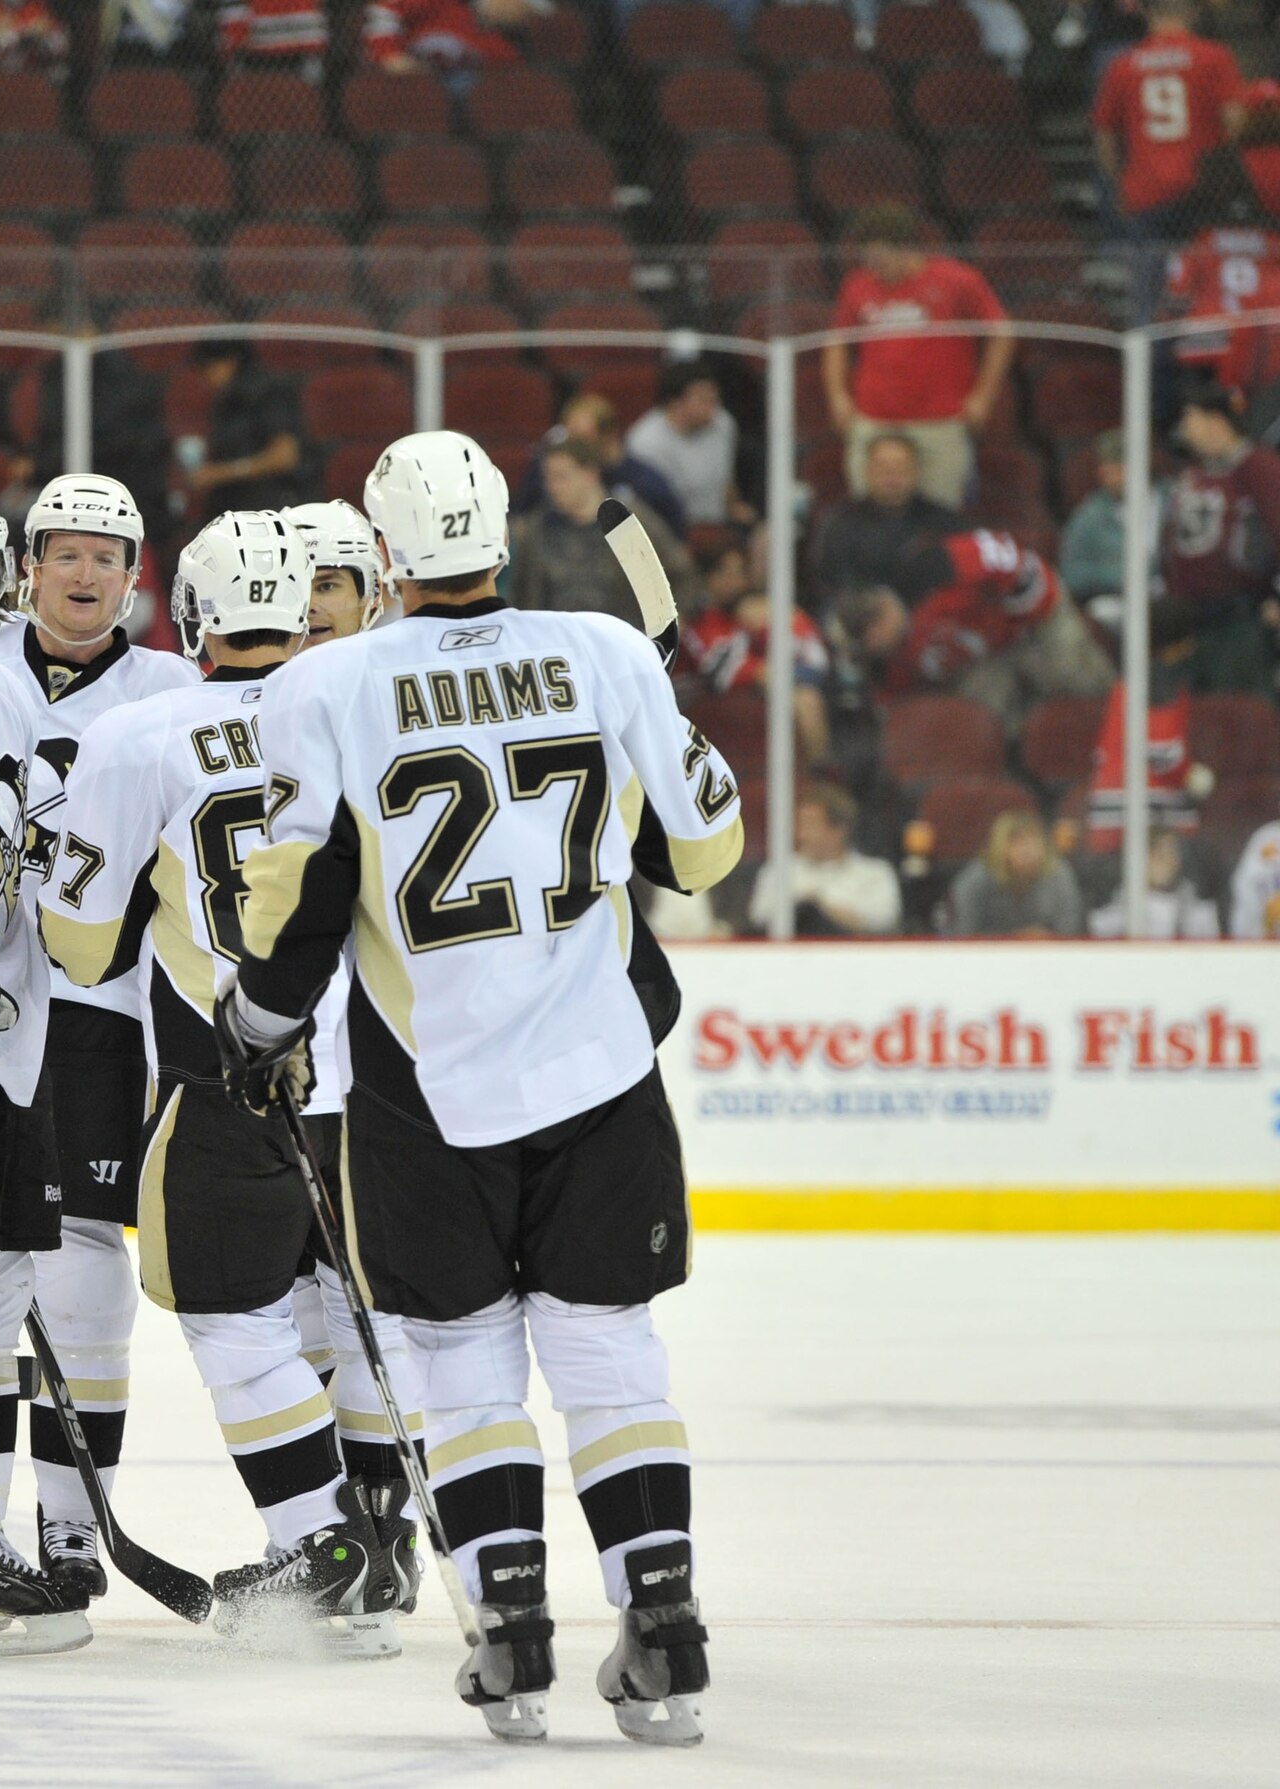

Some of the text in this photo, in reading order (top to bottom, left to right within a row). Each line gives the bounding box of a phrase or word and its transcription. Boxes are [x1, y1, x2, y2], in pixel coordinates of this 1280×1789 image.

[1142, 73, 1190, 141] 9
[72, 503, 111, 512] CCM
[441, 509, 471, 539] 27
[249, 580, 277, 603] 87
[393, 656, 577, 733] ADAMS
[191, 715, 263, 775] CR
[377, 732, 612, 954] 27
[696, 1004, 1262, 1072] Swedish Fish
[493, 1564, 541, 1582] GRAF
[641, 1564, 688, 1586] GRAF
[352, 1622, 381, 1630] Reebok
